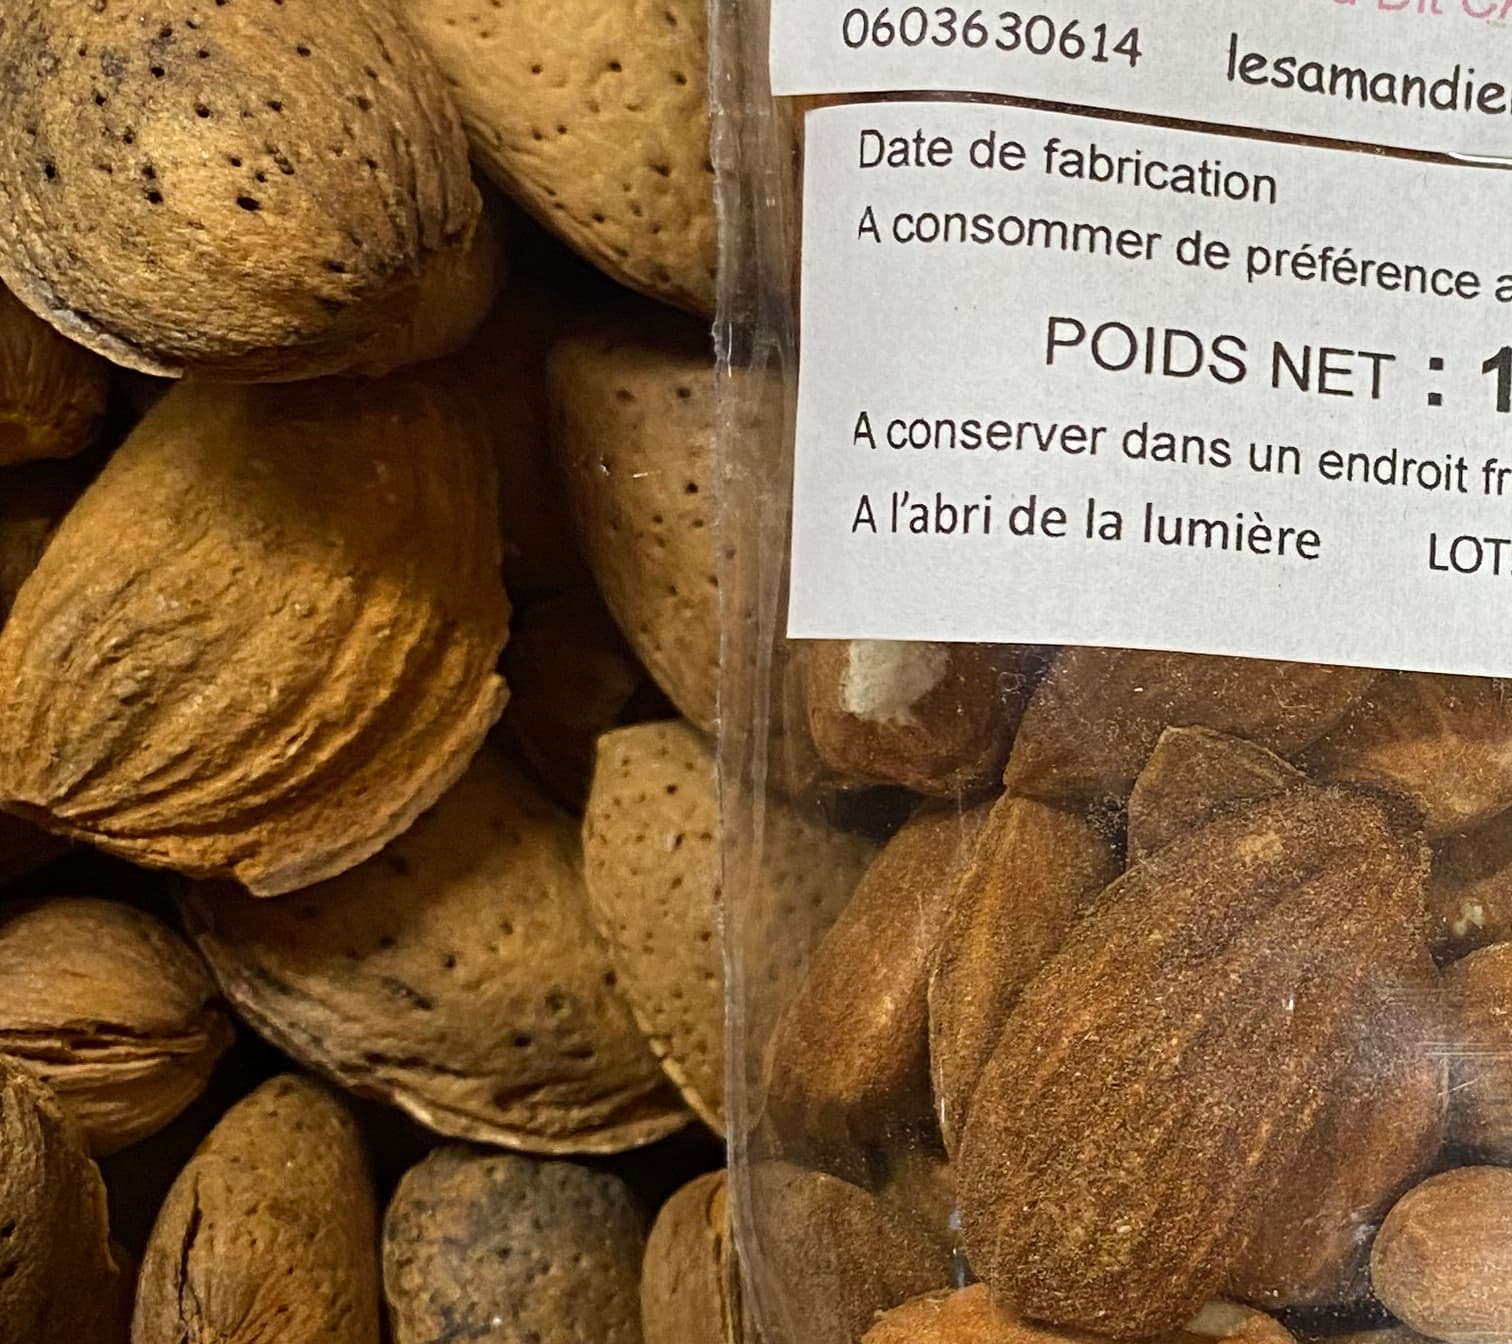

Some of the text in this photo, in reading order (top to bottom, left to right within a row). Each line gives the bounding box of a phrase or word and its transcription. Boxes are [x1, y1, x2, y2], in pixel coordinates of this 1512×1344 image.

[843, 6, 1142, 68] 0603630614
[859, 128, 953, 168] Date
[969, 130, 1026, 171] de
[1043, 138, 1276, 205] fabrication
[858, 206, 881, 243] A
[893, 213, 1162, 260] consommer
[1176, 230, 1231, 270] de
[1247, 243, 1481, 299] préférence
[1046, 316, 1247, 384] POIDS
[1272, 341, 1396, 399] NET
[853, 411, 876, 449] A
[887, 418, 1107, 455] conserver
[1122, 422, 1231, 468] dans
[1249, 443, 1300, 475] un
[1318, 448, 1468, 493] endroit
[852, 494, 877, 533] A
[891, 491, 992, 534] l'abri
[1009, 495, 1067, 538] de
[1086, 498, 1123, 540] la
[1144, 502, 1321, 560] lumière
